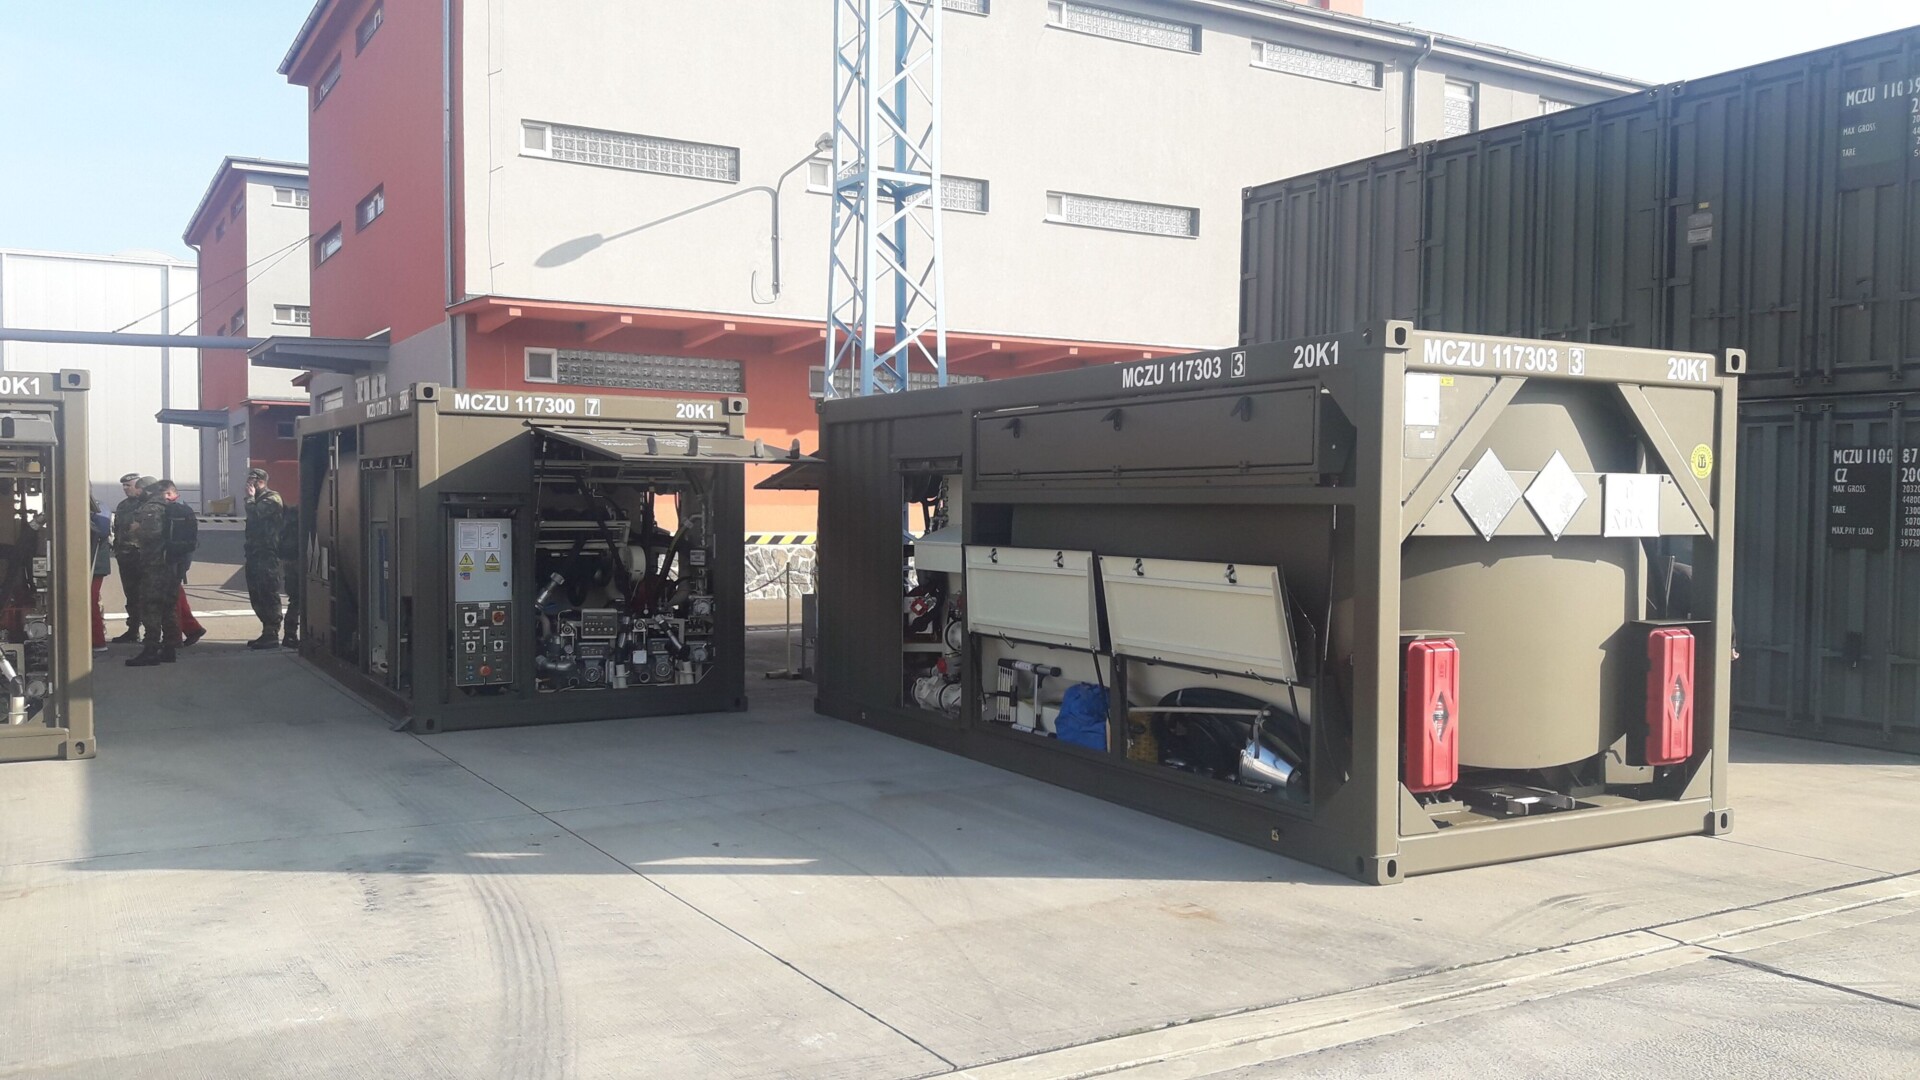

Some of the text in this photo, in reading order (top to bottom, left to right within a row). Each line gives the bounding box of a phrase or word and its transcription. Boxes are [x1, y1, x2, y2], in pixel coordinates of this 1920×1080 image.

[1846, 86, 1876, 107] MCZU
[1842, 127, 1855, 136] MAX
[1122, 340, 1339, 388] MCZU 117303 3 20K1
[1423, 339, 1707, 381] MCZU 117303 3 20K1
[454, 394, 714, 419] MCZU 117300 7 20K1
[1833, 449, 1863, 464] MCZU
[1835, 468, 1848, 482] CZ
[1833, 485, 1845, 493] MAX
[1847, 485, 1866, 493] GROSS
[1832, 506, 1846, 514] TARE
